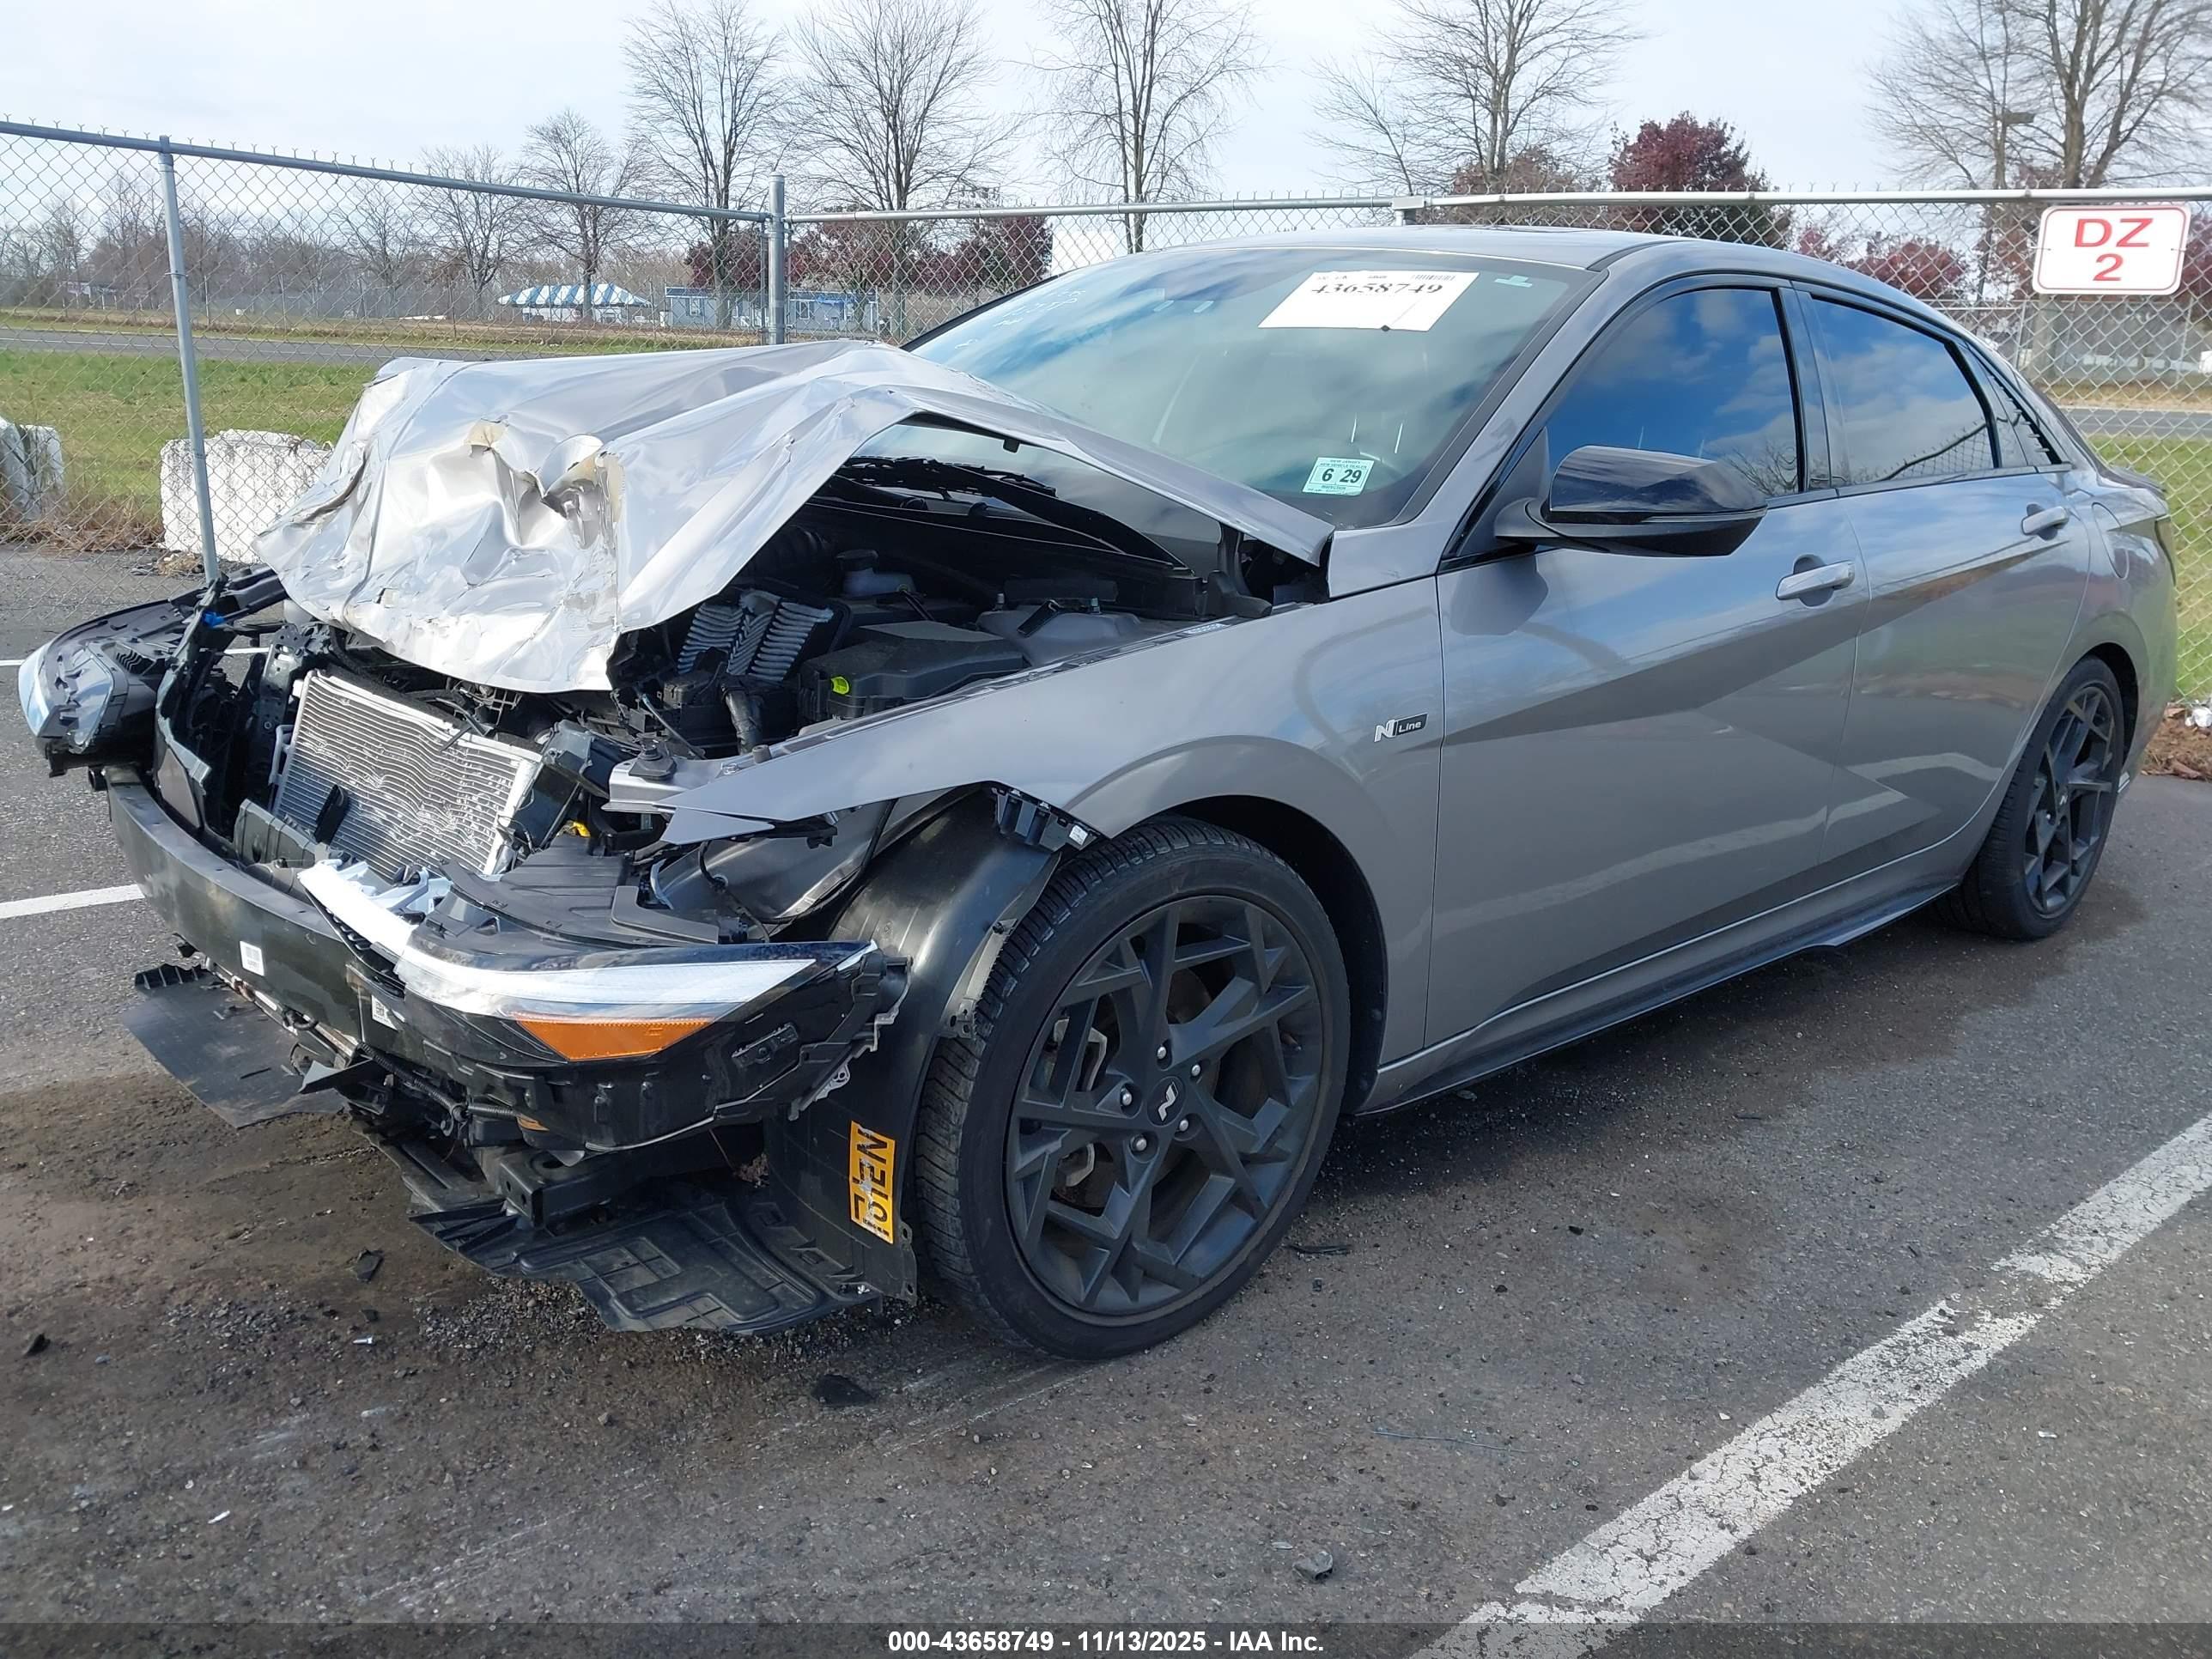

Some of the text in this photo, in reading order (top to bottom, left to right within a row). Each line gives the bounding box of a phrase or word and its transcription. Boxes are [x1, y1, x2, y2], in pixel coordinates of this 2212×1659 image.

[2074, 218, 2154, 247] DZ
[2093, 253, 2124, 282] 2
[1322, 468, 1362, 483] 6 29
[1374, 720, 1422, 743] N Line
